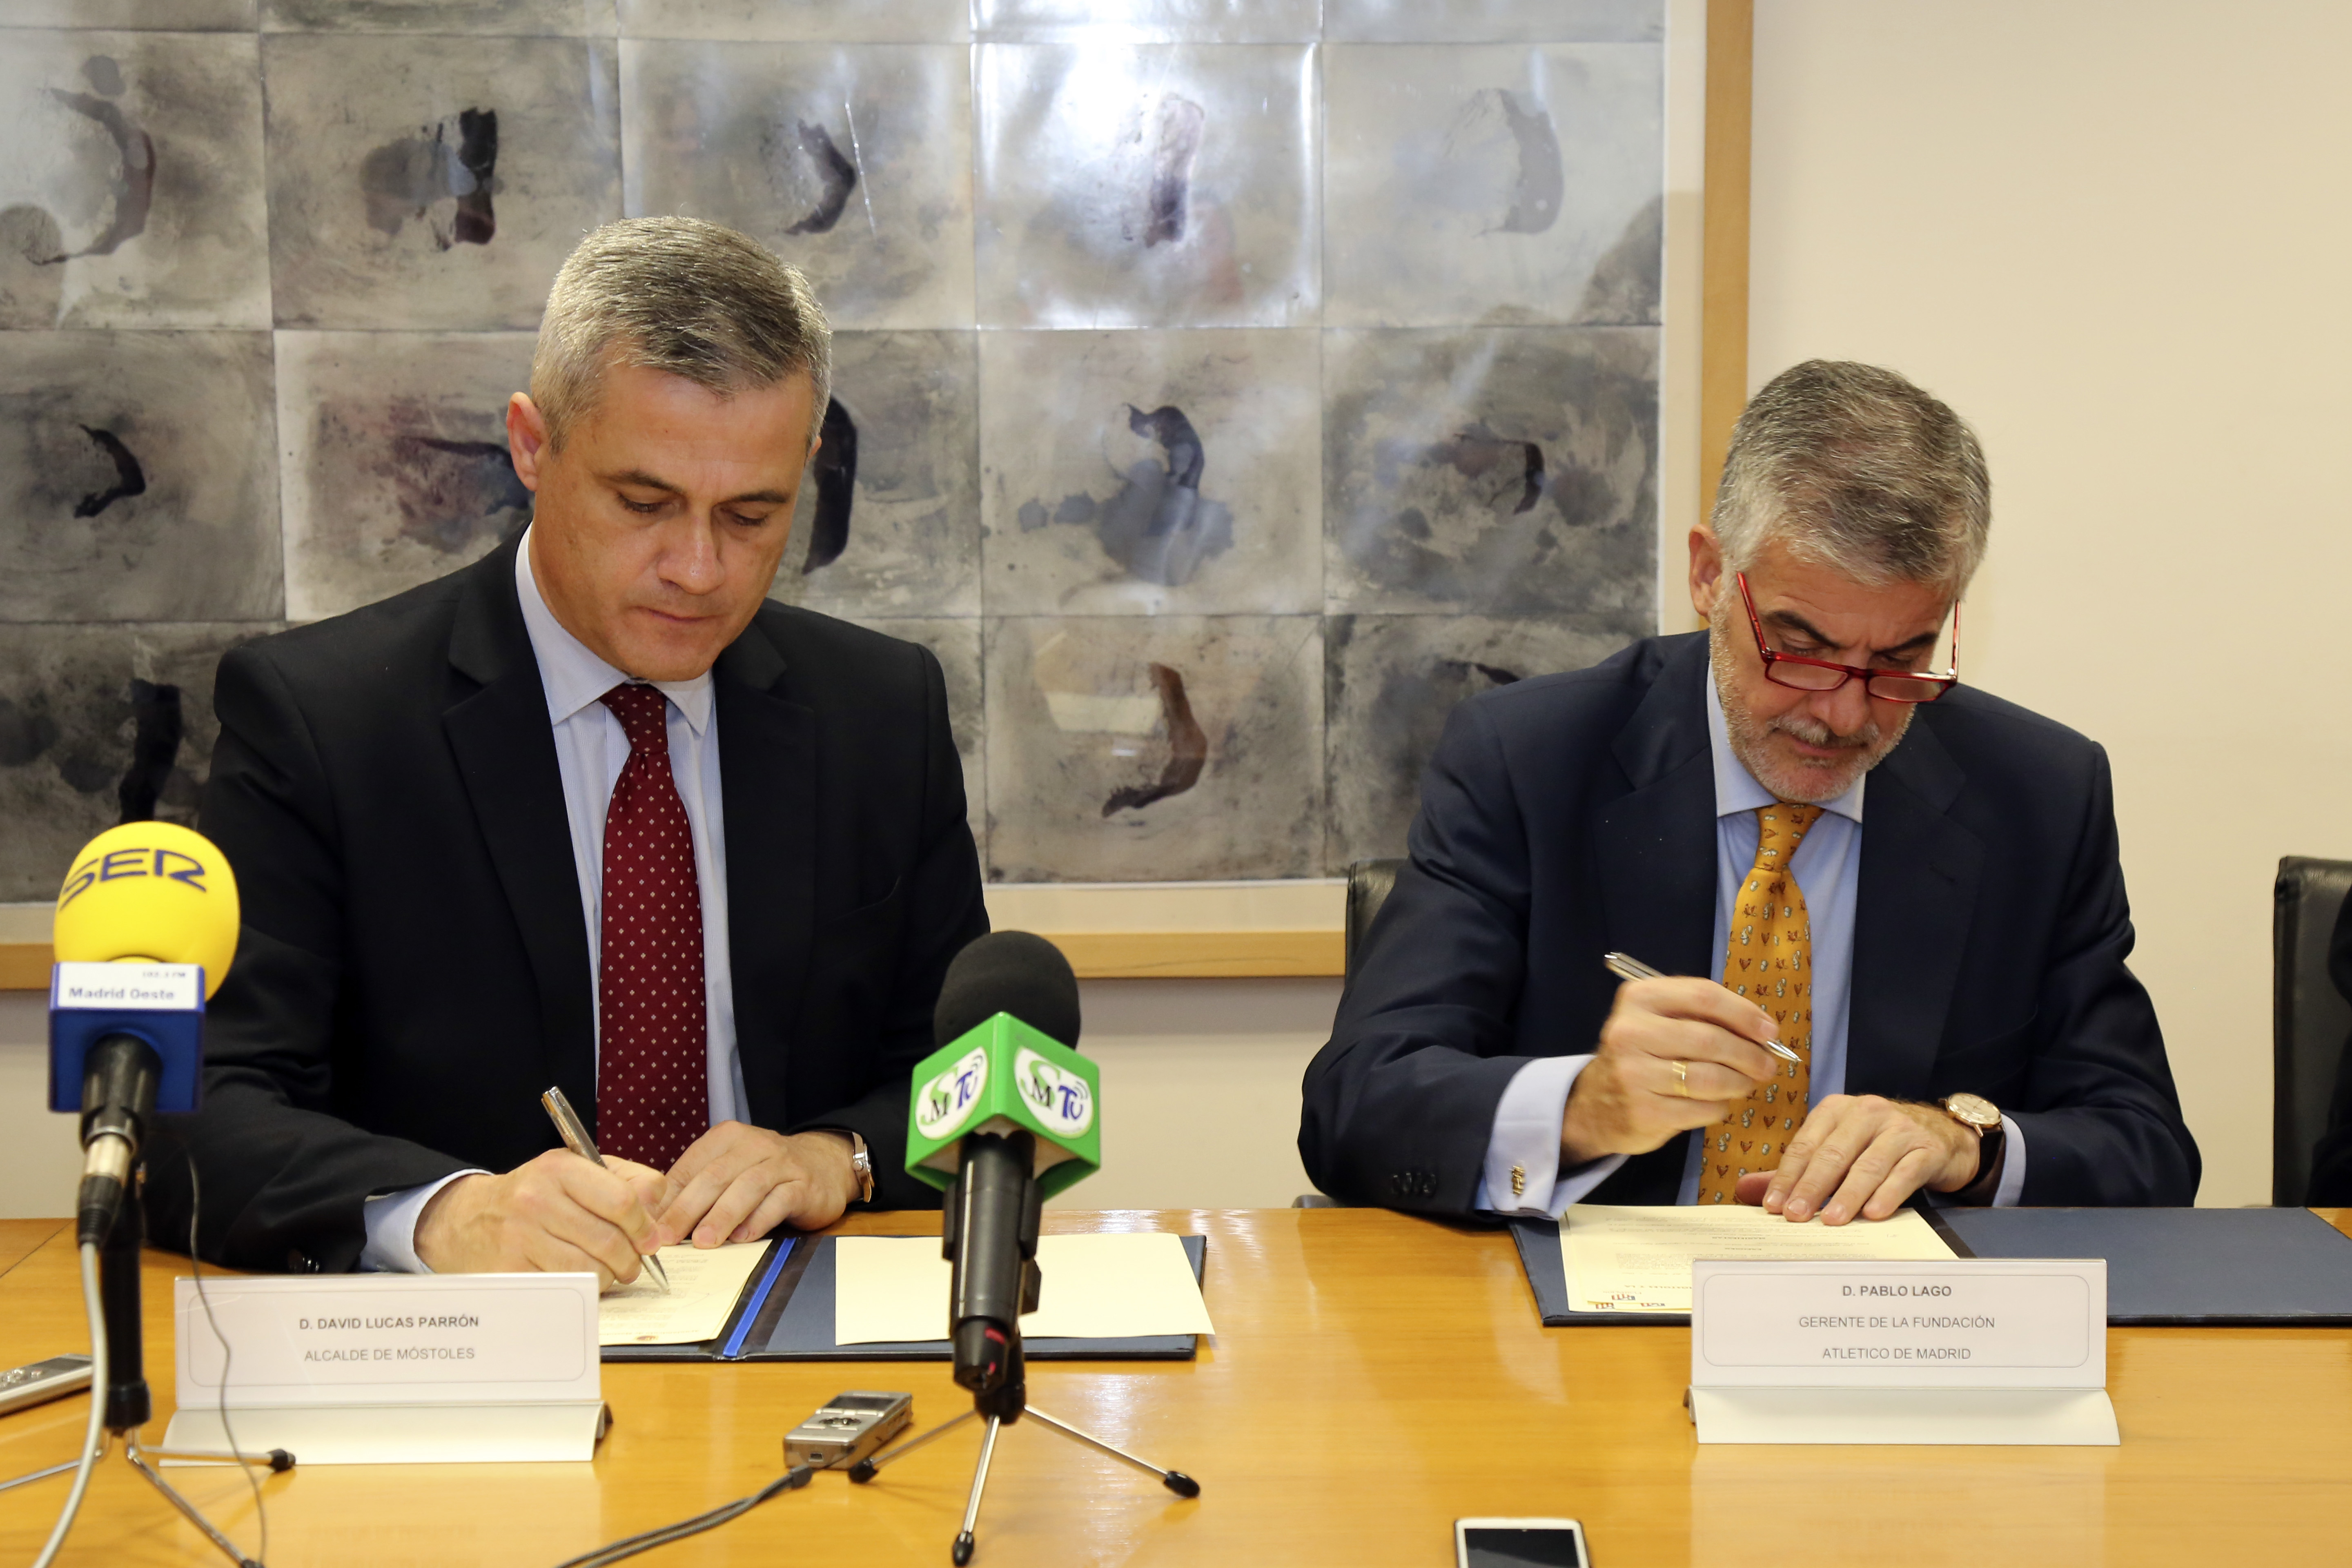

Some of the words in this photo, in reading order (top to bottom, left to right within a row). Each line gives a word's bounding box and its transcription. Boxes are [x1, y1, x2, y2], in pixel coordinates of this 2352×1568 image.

[60, 848, 207, 912] SER
[69, 987, 125, 999] Madrid
[130, 988, 174, 1000] Oeste
[1842, 1285, 1855, 1296] D.
[1860, 1285, 1908, 1297] PABLO
[1912, 1285, 1952, 1297] LAGO
[299, 1318, 312, 1330] D.
[318, 1317, 361, 1330] DAVID
[366, 1316, 414, 1329] LUCAS
[419, 1314, 479, 1327] PARRÓN
[1799, 1316, 1865, 1328] GERENTE
[1869, 1317, 1888, 1327] DE
[1892, 1317, 1909, 1327] LA
[1913, 1315, 1995, 1328] FUNDACIÓN
[305, 1349, 368, 1361] ALCALDE
[374, 1349, 392, 1361] DE
[397, 1346, 475, 1360] MÓSTOLES
[1823, 1348, 1890, 1359] ATLETICO
[1894, 1348, 1913, 1359] DE
[1917, 1348, 1971, 1359] MADRID
